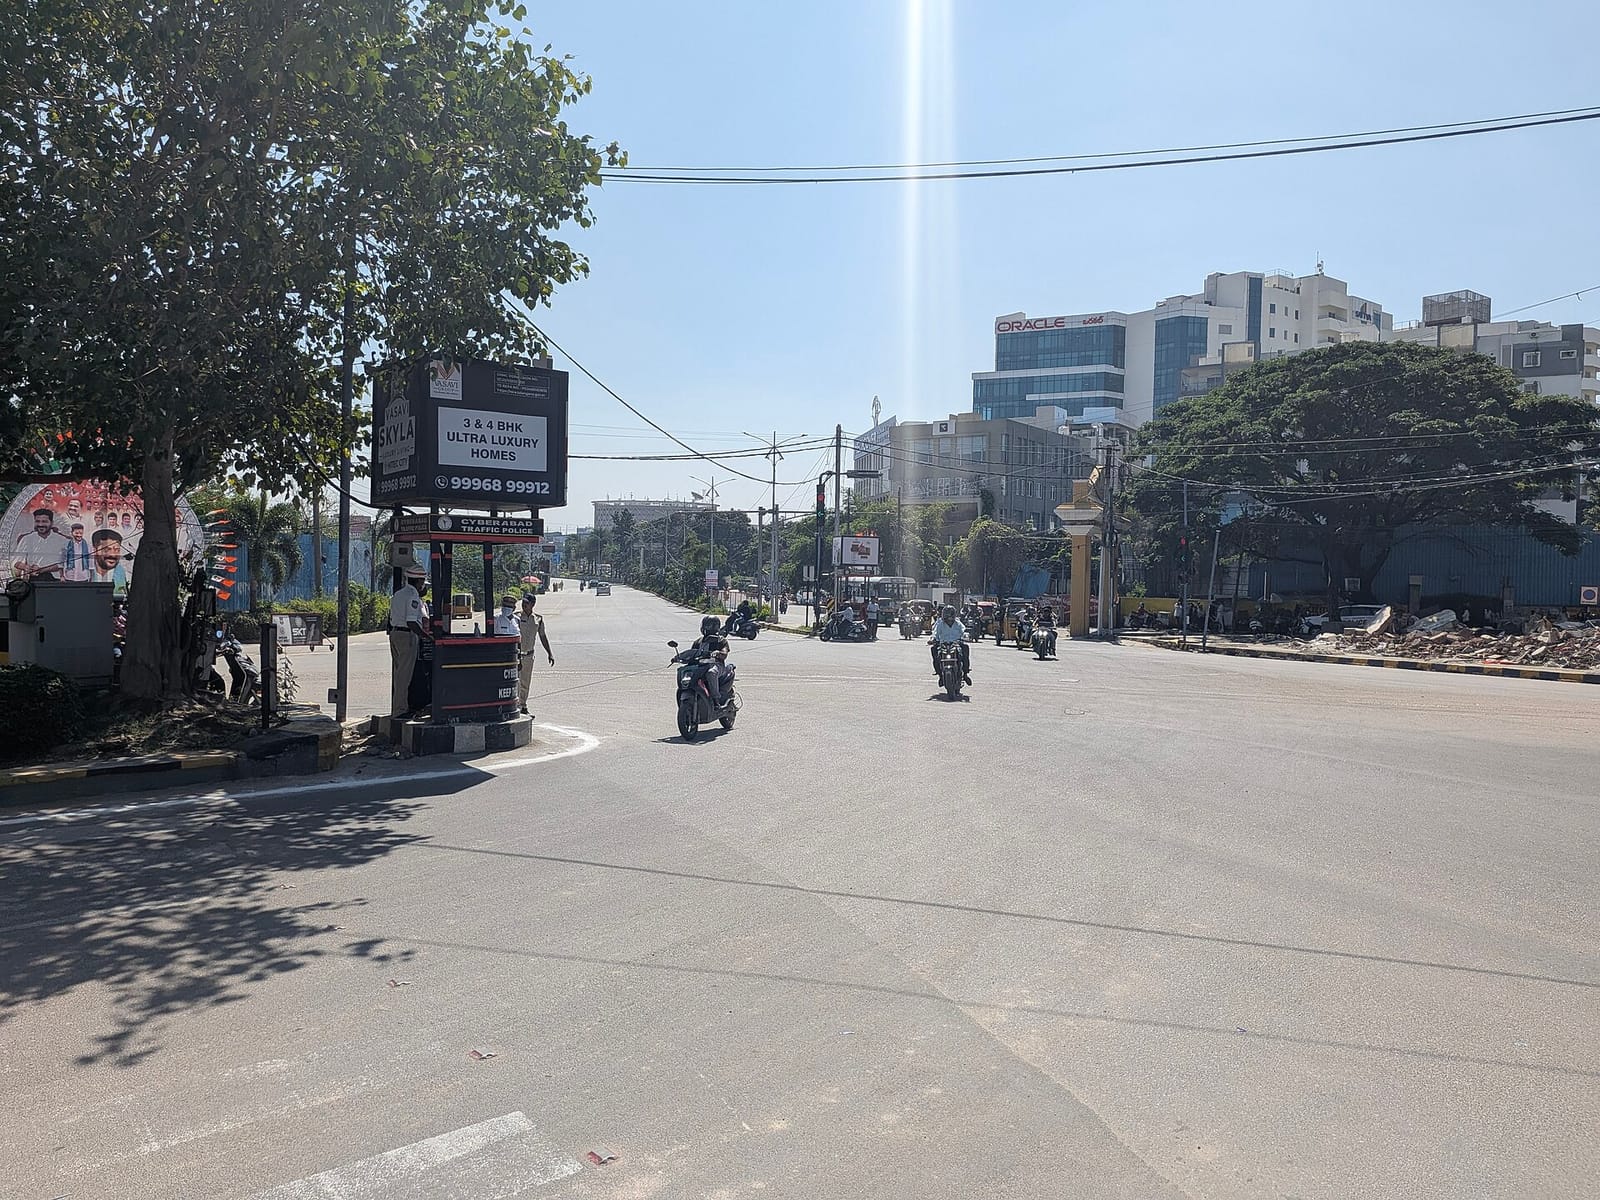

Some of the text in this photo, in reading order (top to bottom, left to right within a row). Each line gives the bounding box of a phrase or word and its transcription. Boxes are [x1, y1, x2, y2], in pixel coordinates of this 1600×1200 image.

[997, 318, 1065, 332] ORACLE
[463, 418, 523, 433] 3 & 4 BHK
[379, 419, 414, 448] SKYLA
[447, 431, 539, 449] ULTRA LUXURY
[471, 448, 516, 462] HOMES
[381, 475, 416, 493] 99968 99912
[450, 476, 550, 494] 99968 99912
[460, 518, 533, 528] CYBERABAD
[461, 526, 534, 535] TRAFFIC POLICE
[498, 687, 512, 699] KEEP
